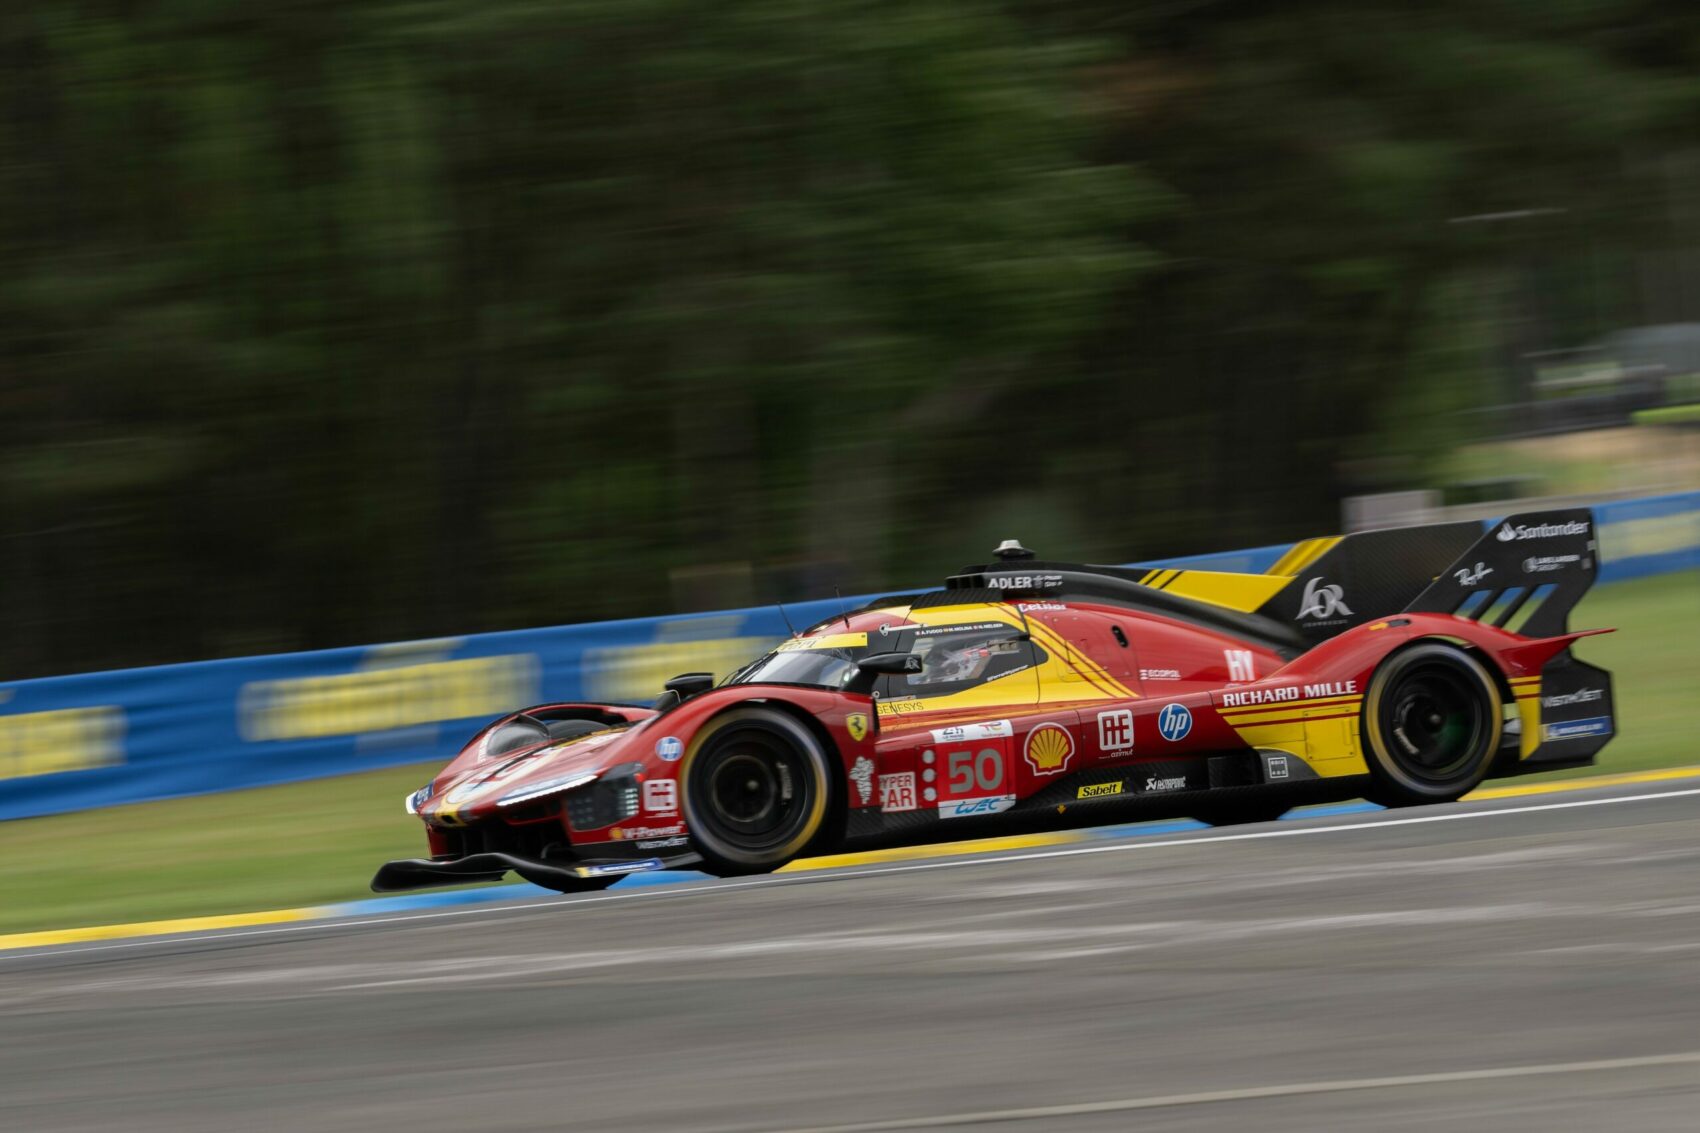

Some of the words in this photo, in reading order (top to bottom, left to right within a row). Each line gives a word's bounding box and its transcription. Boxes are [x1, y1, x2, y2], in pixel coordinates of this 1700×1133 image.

[1515, 521, 1589, 540] Santander
[988, 576, 1032, 590] ADLER
[1222, 687, 1299, 707] RICHARD
[1303, 680, 1358, 698] MILLE
[878, 701, 924, 715] GENESYS
[1163, 705, 1188, 740] hp
[948, 748, 1004, 794] 50
[1082, 784, 1117, 797] Sabelt
